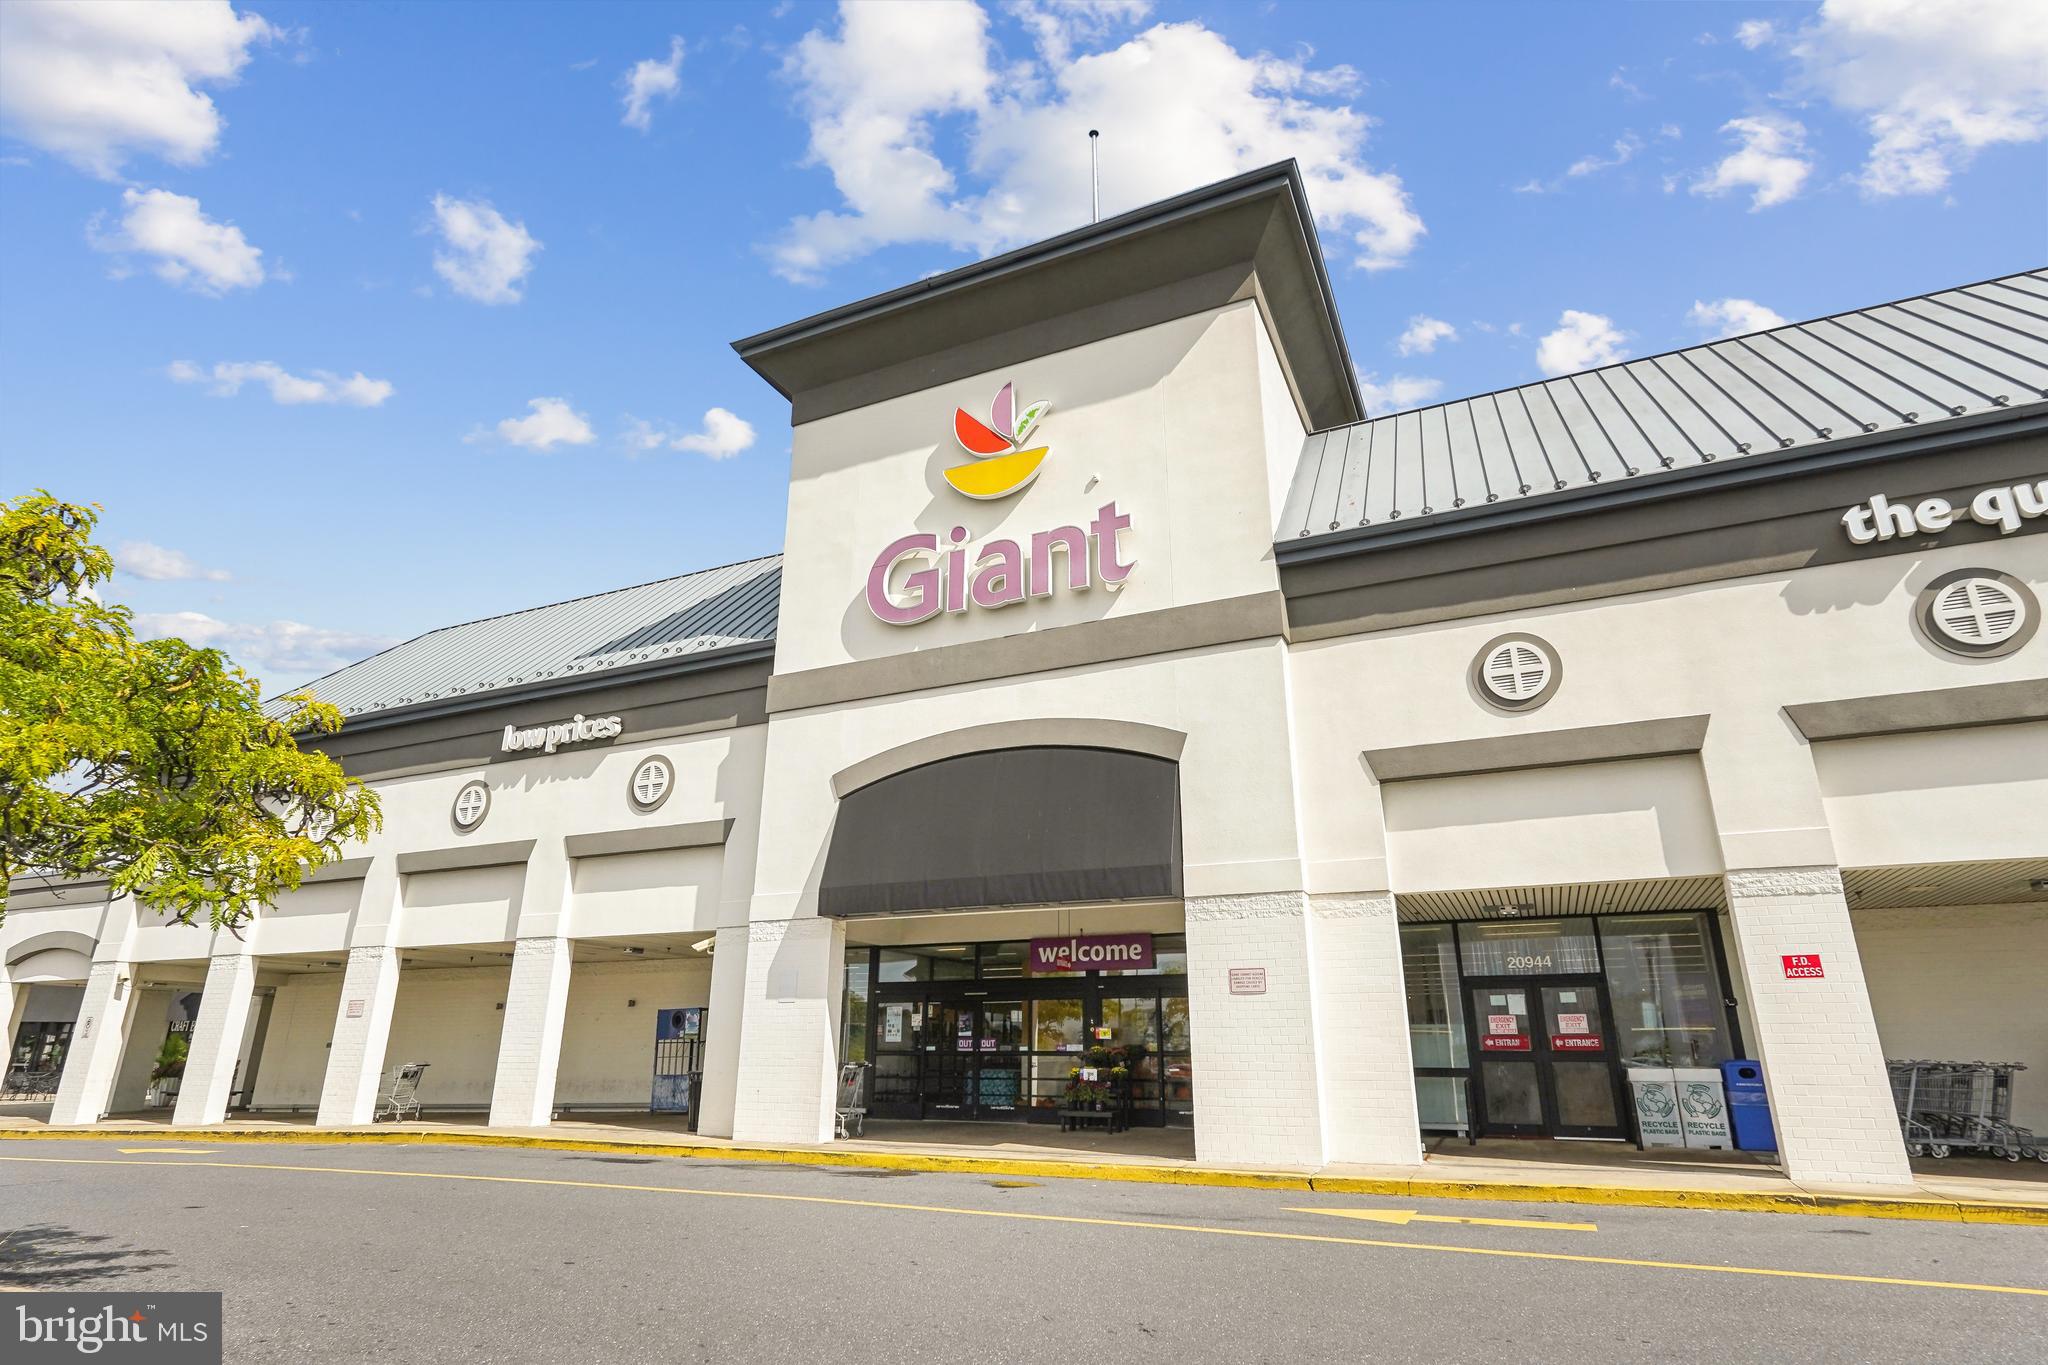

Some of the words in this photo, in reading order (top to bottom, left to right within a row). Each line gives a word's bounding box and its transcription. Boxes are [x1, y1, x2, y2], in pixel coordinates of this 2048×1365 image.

[1840, 493, 1953, 545] the
[1969, 480, 2048, 535] qu
[865, 501, 1139, 626] Giant
[501, 724, 546, 752] low
[545, 714, 623, 753] prices
[1038, 939, 1142, 963] welcome
[1507, 955, 1552, 969] 20944
[1791, 957, 1811, 966] F.D.
[1786, 967, 1823, 977] ACCESS
[171, 1020, 190, 1032] CRAFT
[958, 1039, 973, 1048] OUT
[980, 1039, 996, 1048] OUT
[1565, 1038, 1600, 1047] ENTRANCE
[1641, 1120, 1679, 1128] RECYCLE
[1687, 1121, 1726, 1130] RECYCLE
